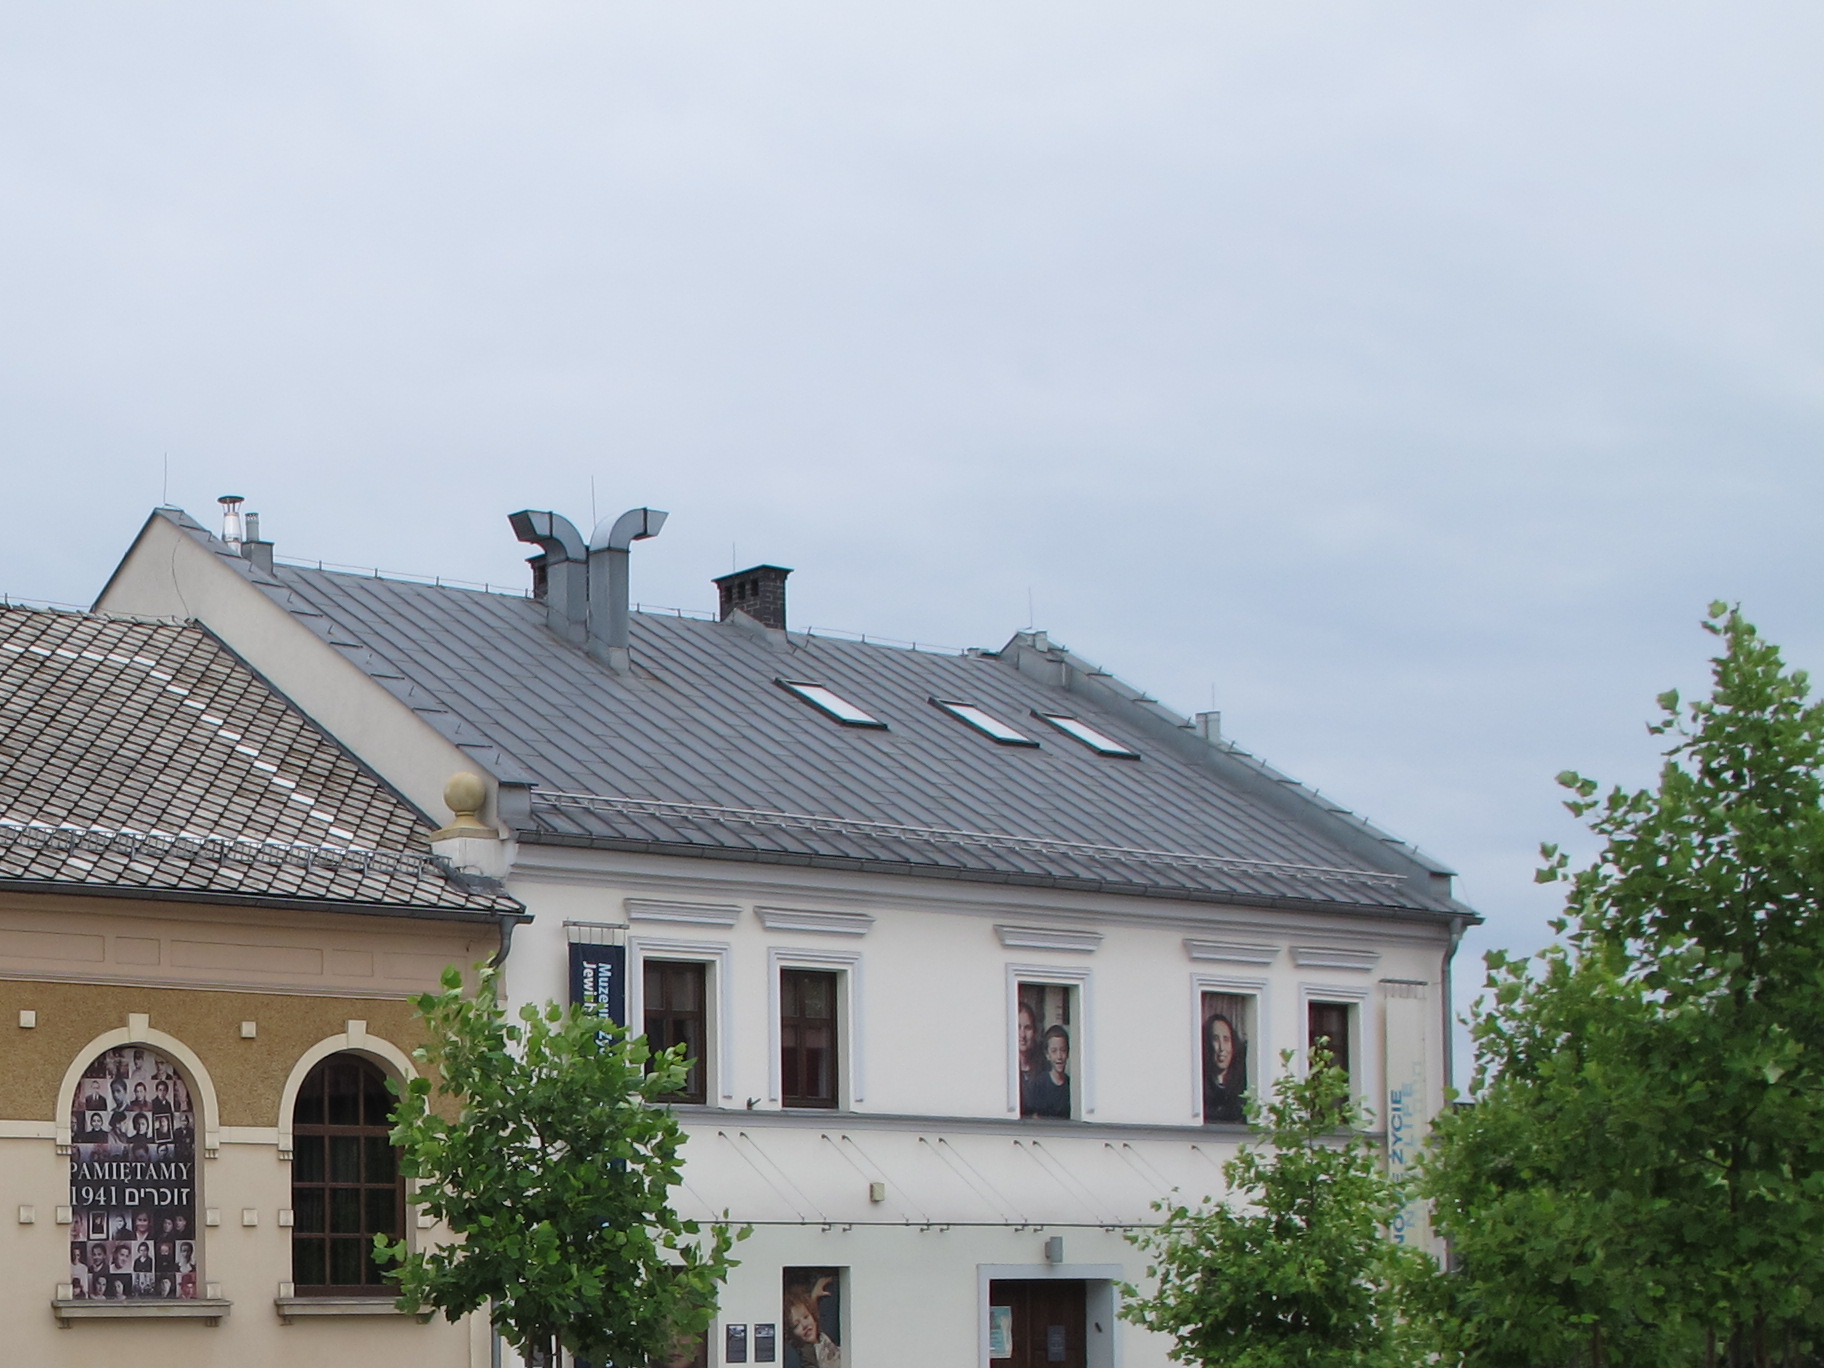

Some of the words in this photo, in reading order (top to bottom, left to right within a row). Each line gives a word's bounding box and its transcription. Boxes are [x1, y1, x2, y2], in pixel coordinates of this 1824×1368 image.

[582, 961, 597, 1013] Jewih
[598, 963, 612, 1022] Muzeu
[1388, 1089, 1404, 1165] ŻYCIE
[70, 1161, 192, 1184] PAMIĘTAMY
[71, 1185, 118, 1206] 1941
[124, 1187, 191, 1206] זוכרים
